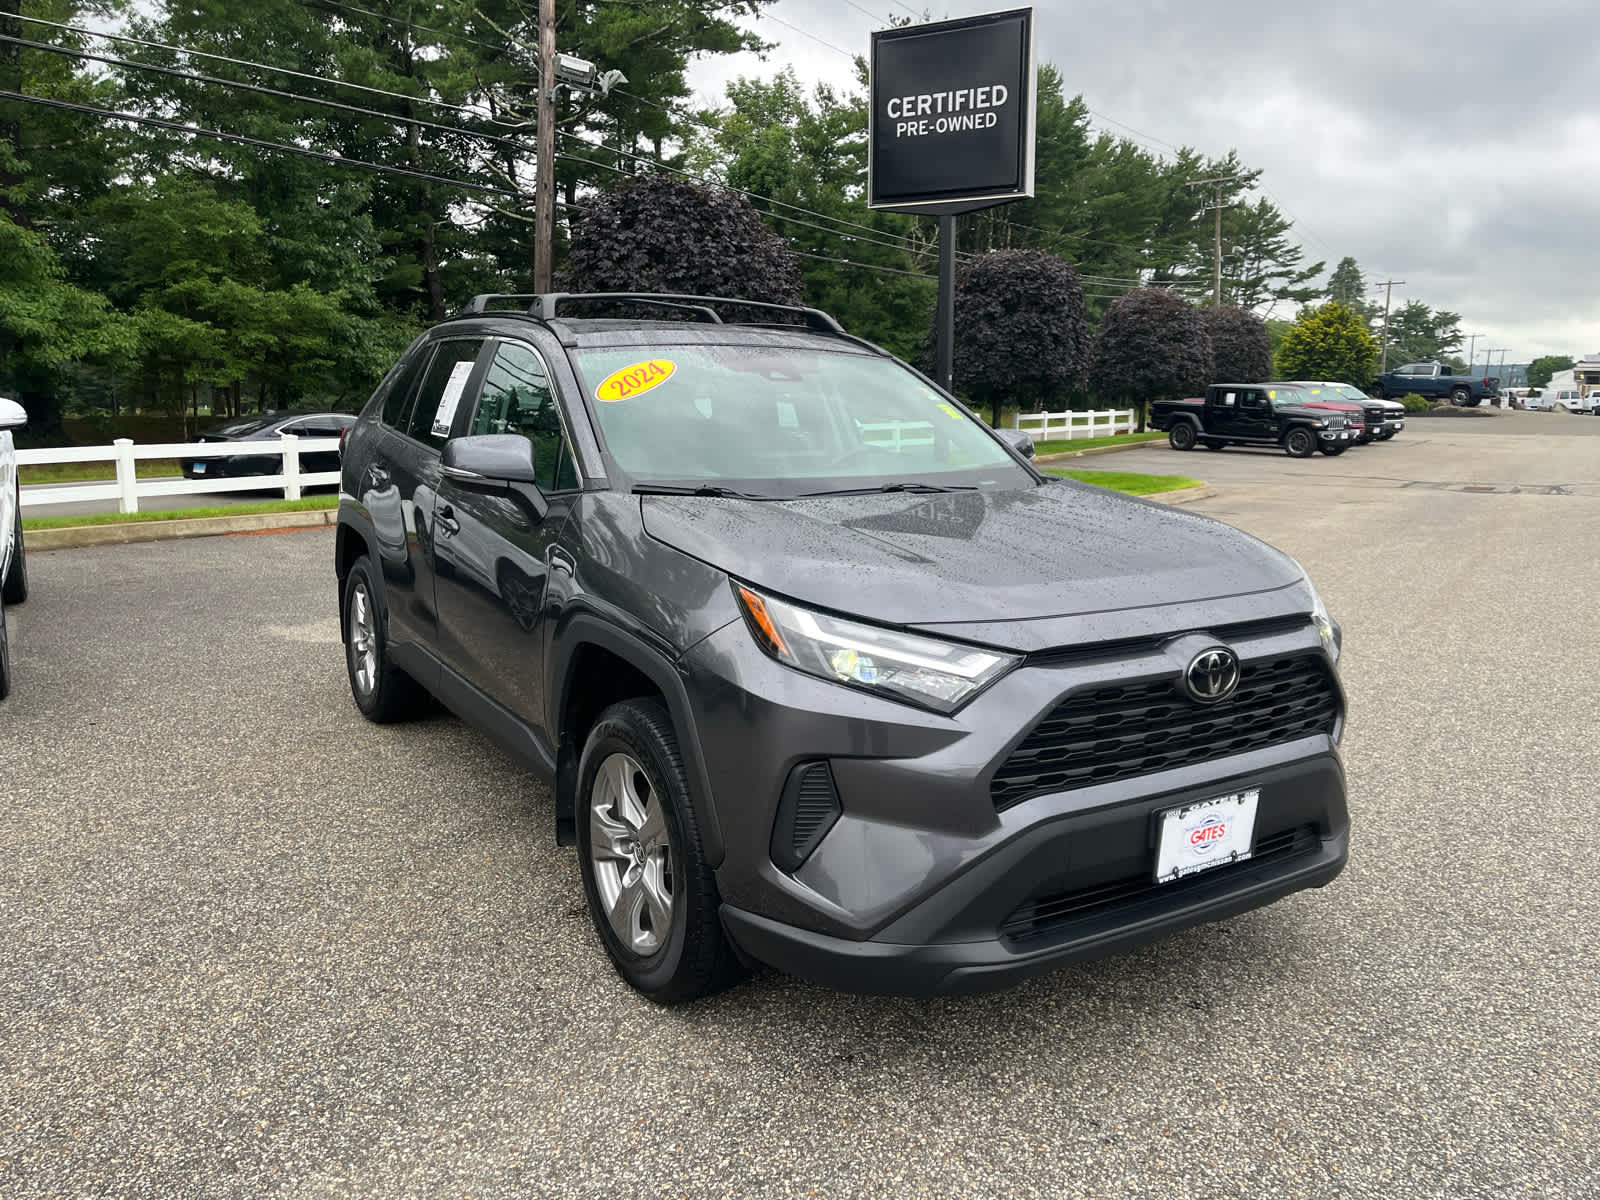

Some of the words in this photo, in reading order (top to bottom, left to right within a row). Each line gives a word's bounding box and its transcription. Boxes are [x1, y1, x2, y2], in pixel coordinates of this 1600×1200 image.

[887, 84, 1008, 119] CERTIFIED
[896, 112, 997, 138] PRE-OWNED
[610, 362, 666, 397] 2024
[1190, 824, 1225, 845] GATES
